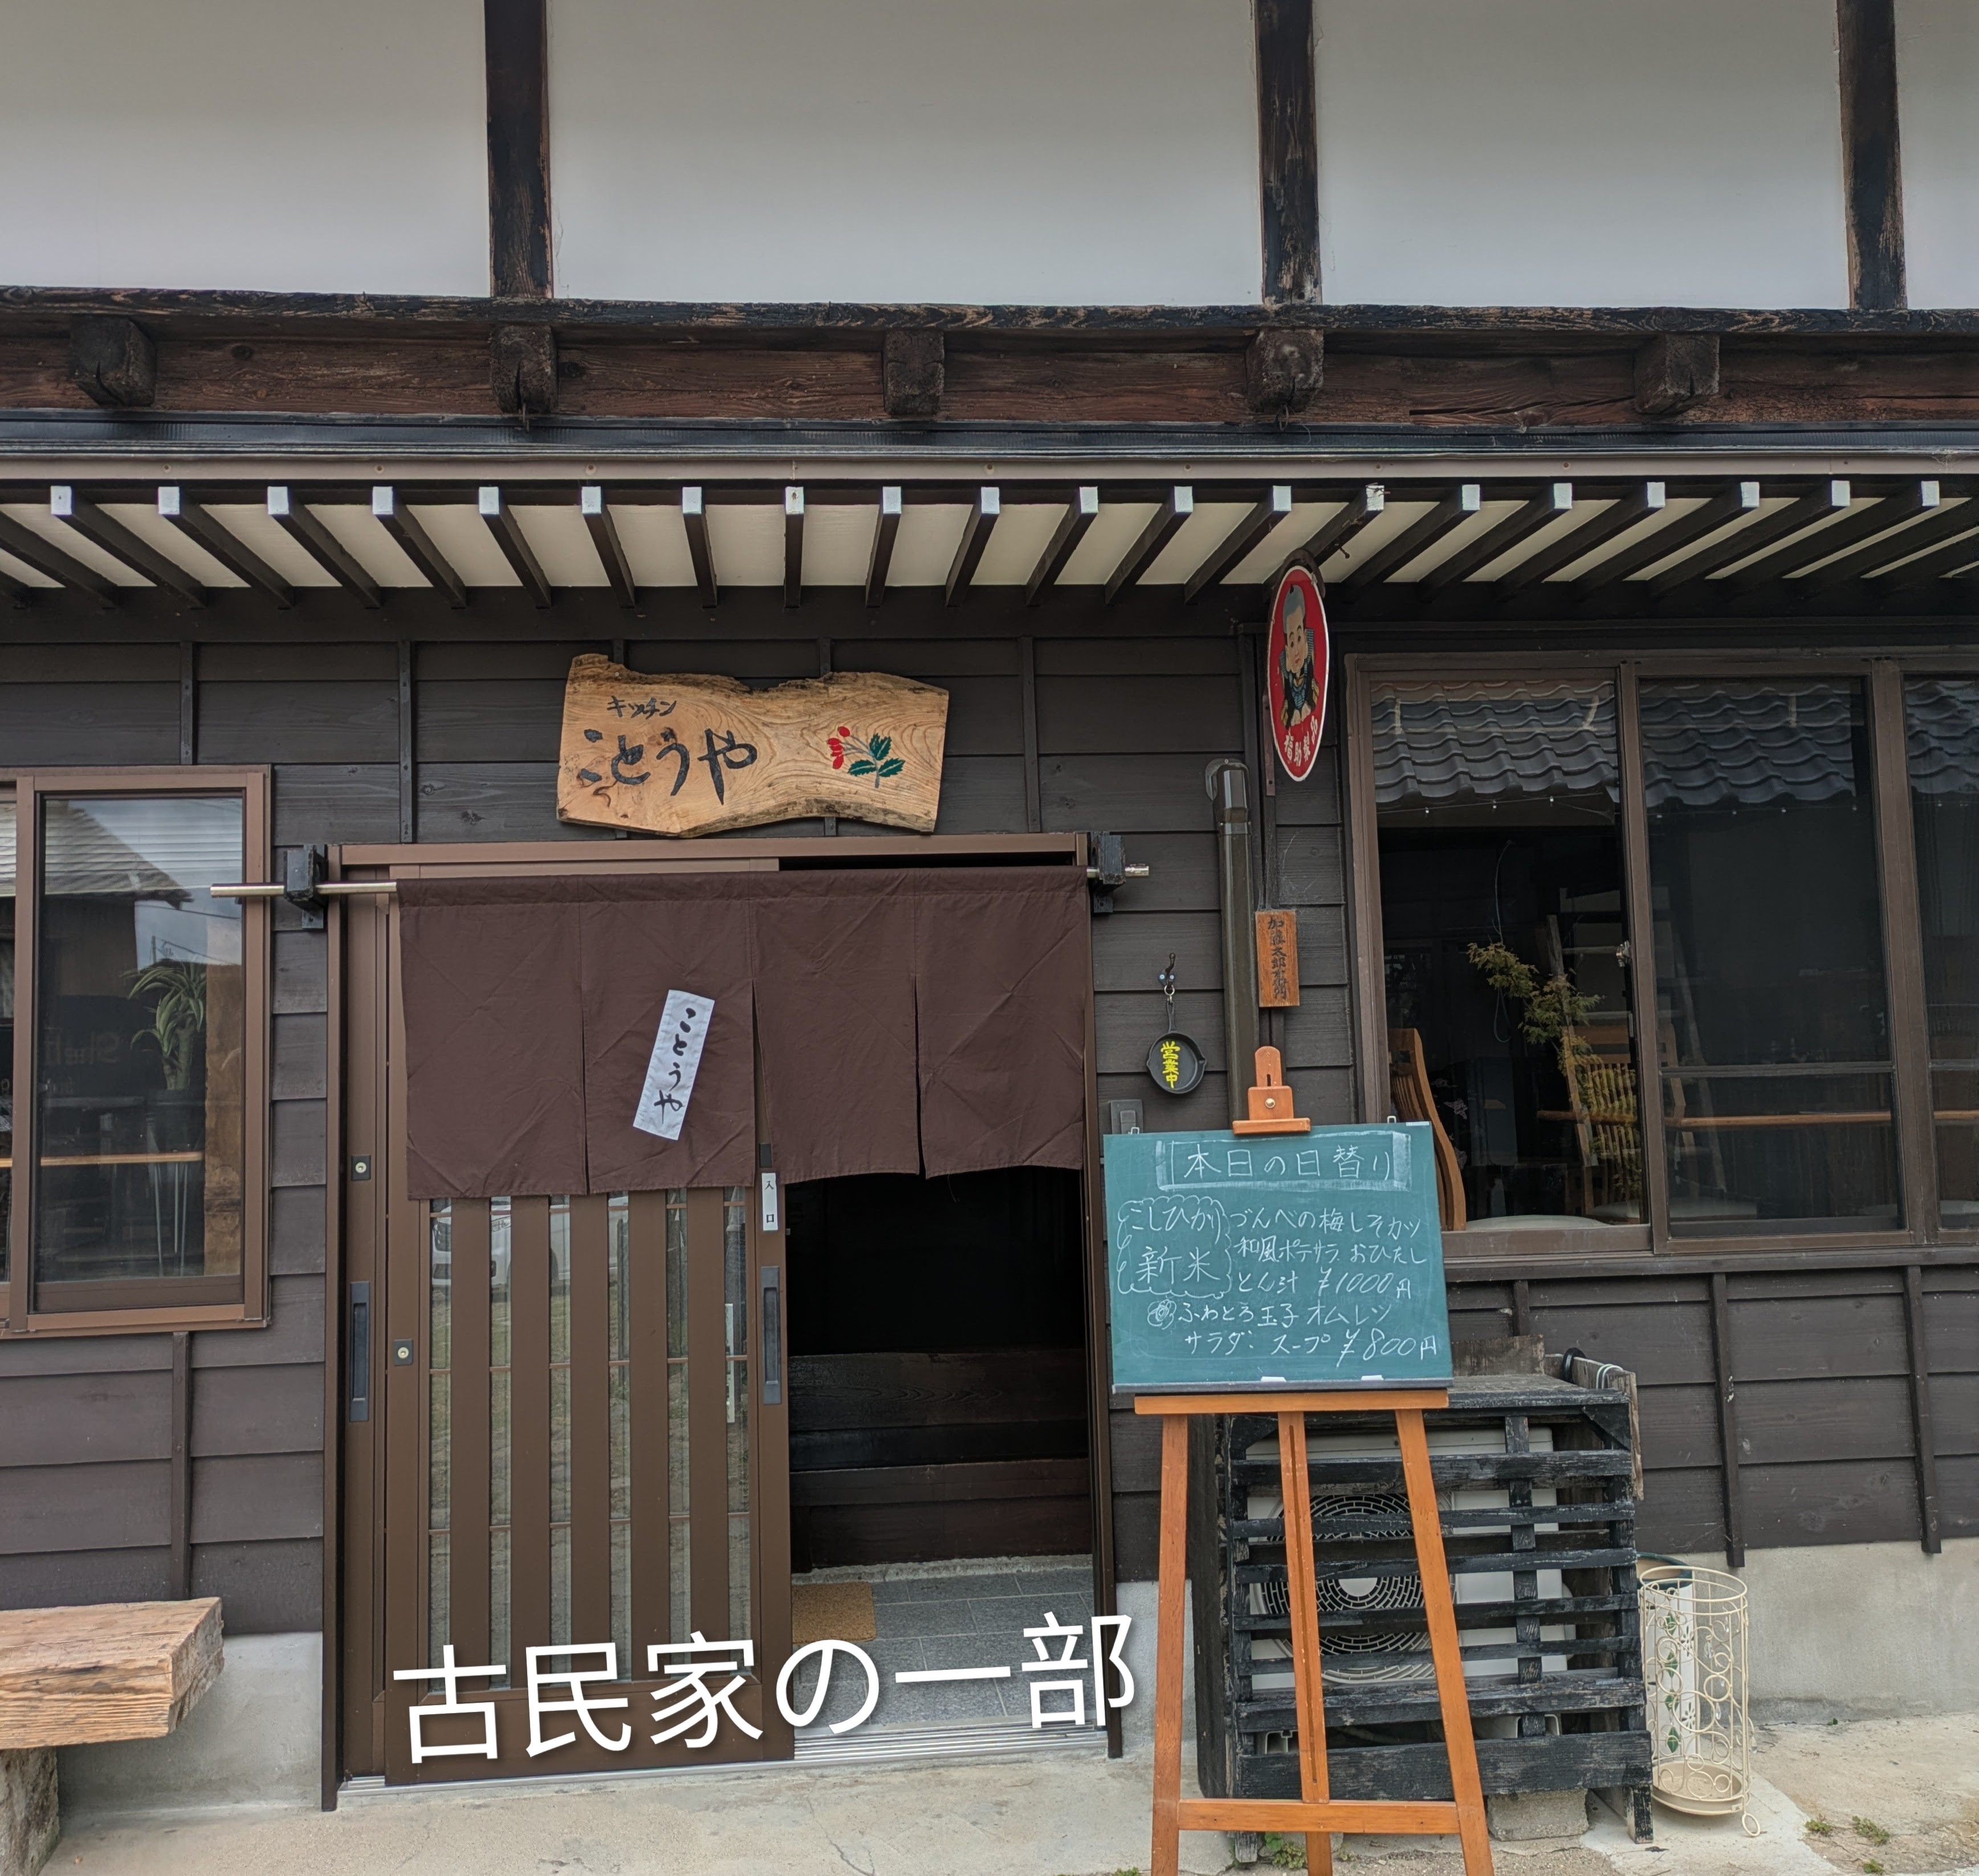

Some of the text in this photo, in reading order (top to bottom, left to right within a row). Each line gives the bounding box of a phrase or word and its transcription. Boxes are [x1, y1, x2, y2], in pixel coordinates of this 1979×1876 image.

[606, 695, 677, 719] キッチン
[580, 727, 758, 805] ことうや
[654, 1008, 697, 1124] ことうや
[1160, 1040, 1181, 1089] 営業中
[1183, 1143, 1390, 1180] 本日の日替り
[764, 1180, 775, 1224] 入口
[1130, 1206, 1221, 1245] こしひかり
[1135, 1246, 1221, 1284] 新米
[1350, 1243, 1427, 1264] おひたし
[1238, 1270, 1298, 1294] とん汁
[1271, 1333, 1331, 1355] スープ
